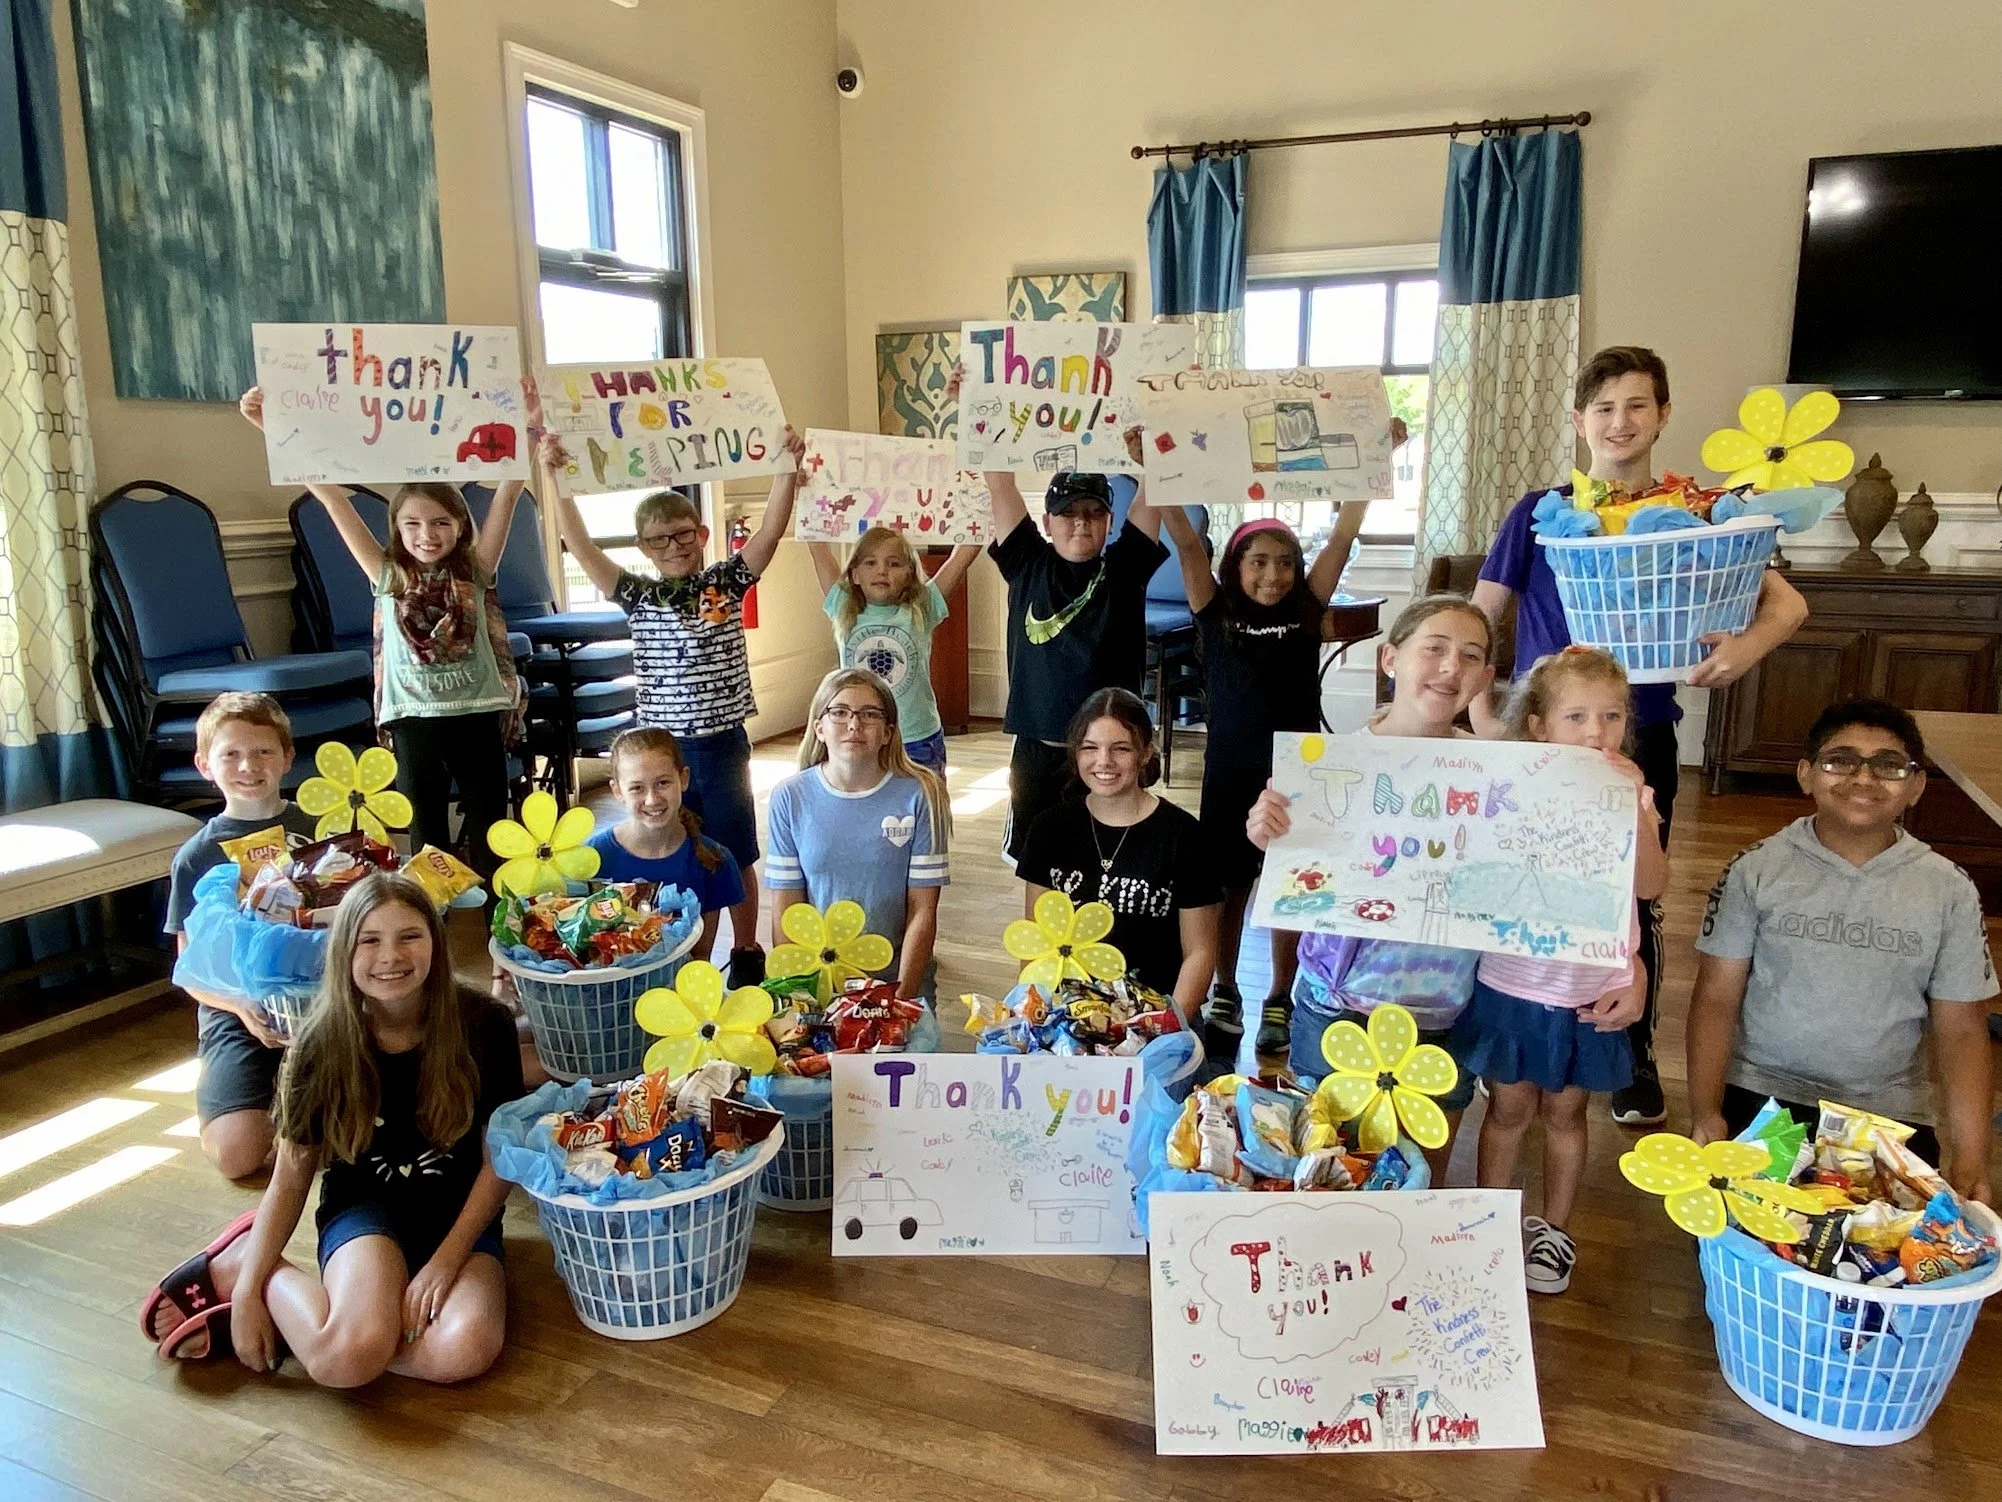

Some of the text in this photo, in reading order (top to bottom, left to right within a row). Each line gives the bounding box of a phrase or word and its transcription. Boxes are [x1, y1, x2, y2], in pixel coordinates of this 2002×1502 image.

[556, 359, 728, 402] THANKS
[360, 393, 445, 446] you!
[609, 400, 693, 439] FOR
[1008, 398, 1103, 445] you!
[1372, 824, 1467, 878] you!
[1779, 911, 1924, 957] adidas
[1045, 1067, 1134, 1137] you!
[1058, 1163, 1114, 1188] Claire
[1267, 1289, 1330, 1336] you!
[1414, 1294, 1442, 1317] The
[1433, 1307, 1480, 1334] Kindness
[1443, 1323, 1487, 1354] Confetti
[1464, 1342, 1493, 1365] Crew
